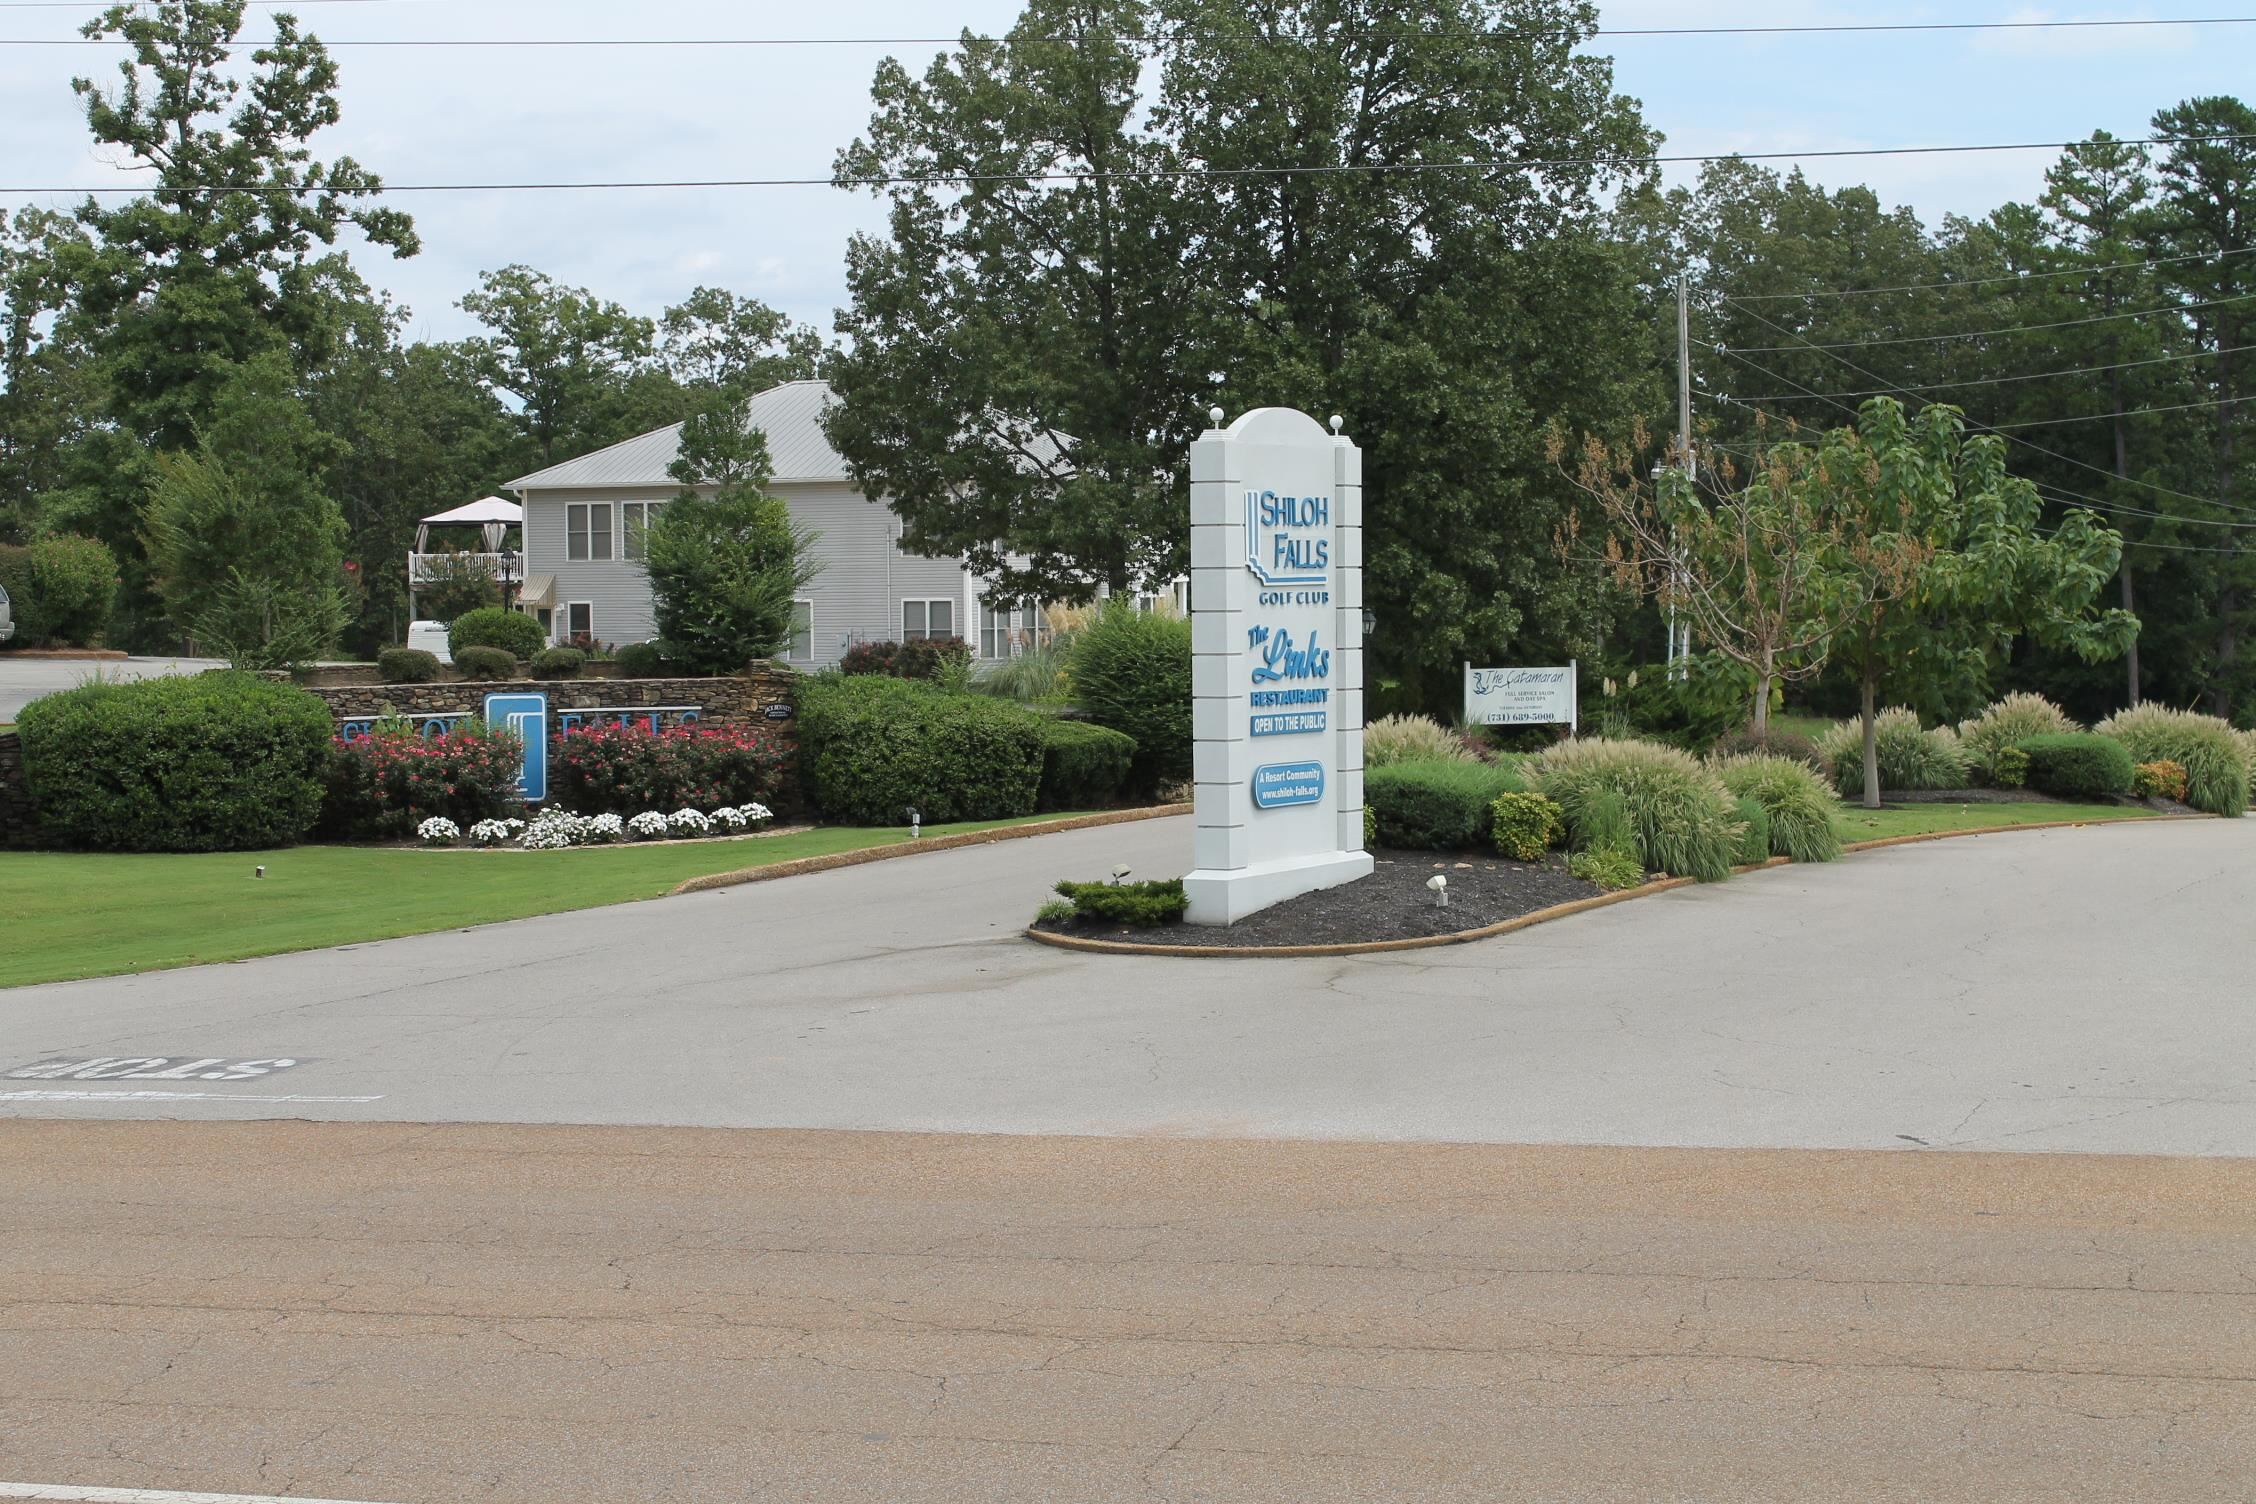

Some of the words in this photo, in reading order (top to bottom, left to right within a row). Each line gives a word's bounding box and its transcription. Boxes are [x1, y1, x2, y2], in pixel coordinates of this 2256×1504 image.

[1260, 490, 1329, 527] SHILOH
[1273, 532, 1329, 569] FALLS
[1259, 591, 1294, 606] GOLF
[1298, 591, 1329, 604] CLUB
[1252, 627, 1330, 685] Links
[1485, 670, 1504, 685] The
[1507, 670, 1564, 686] Catamaran
[1250, 688, 1330, 707] RESTAURANT
[1254, 717, 1273, 733] OPEN
[1274, 716, 1284, 731] TO
[1285, 715, 1299, 730] THE
[1300, 714, 1325, 729] PUBLIC
[1487, 713, 1510, 722] (731)
[1259, 772, 1265, 784] A
[1265, 771, 1286, 782] Resort
[1286, 768, 1321, 781] Community
